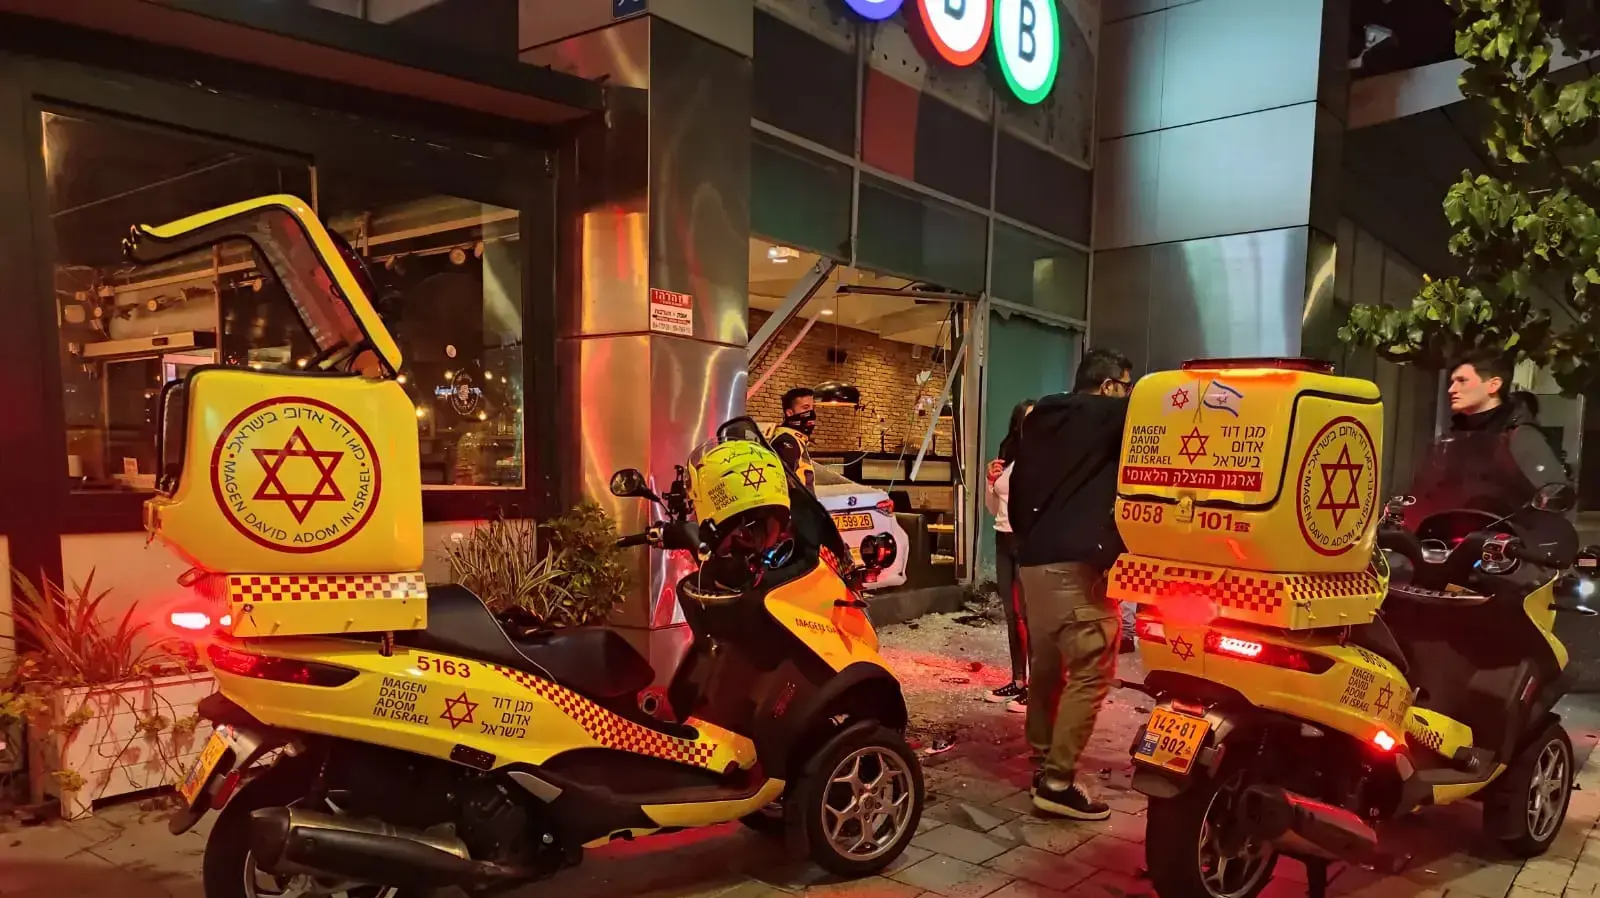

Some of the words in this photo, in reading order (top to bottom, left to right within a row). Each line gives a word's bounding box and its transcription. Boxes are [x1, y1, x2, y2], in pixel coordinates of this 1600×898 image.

[1018, 0, 1037, 63] B
[283, 407, 325, 424] אדום
[226, 411, 278, 454] בישראל
[329, 417, 350, 438] דוד
[1131, 425, 1167, 435] MAGEN
[1220, 425, 1241, 439] דוד
[1244, 425, 1266, 439] מגן
[1130, 435, 1160, 445] DAVID
[1231, 440, 1264, 453] אדום
[346, 438, 366, 460] מגן
[1129, 445, 1160, 455] ADOM
[1128, 454, 1138, 464] IN
[1140, 455, 1172, 465] ISRAEL
[1212, 453, 1261, 468] בישראל
[1126, 468, 1169, 483] הלאומי
[1173, 469, 1216, 484] ההצלה
[1219, 473, 1256, 488] ארגון
[224, 461, 247, 513] MAGEN
[244, 512, 288, 542] DAVID
[293, 524, 340, 544] ADOM
[340, 513, 355, 527] IN
[351, 469, 371, 514] ISRAEL
[1121, 502, 1164, 524] 5058
[1197, 511, 1233, 531] 101
[1303, 475, 1313, 521] MAGEN
[1308, 521, 1330, 546] DAVID
[1331, 528, 1355, 546] ADOM
[1355, 517, 1364, 531] IN
[1361, 476, 1374, 517] ISRAEL
[795, 617, 826, 632] MAGEN
[416, 655, 471, 678] 5163
[1352, 666, 1375, 684] MAGEN
[381, 676, 428, 694] MAGEN
[1348, 676, 1369, 691] DAVID
[379, 687, 418, 702] DAVID
[1344, 685, 1366, 700] ADOM
[375, 697, 416, 712] ADOM
[491, 696, 512, 709] דוד
[514, 699, 534, 713] מגן
[1339, 694, 1349, 705] IN
[1349, 697, 1370, 712] ISRAEL
[372, 706, 387, 718] IN
[390, 709, 430, 726] ISRAEL
[501, 712, 531, 726] אדום
[480, 720, 526, 739] בישראל
[1160, 736, 1186, 756] 902
